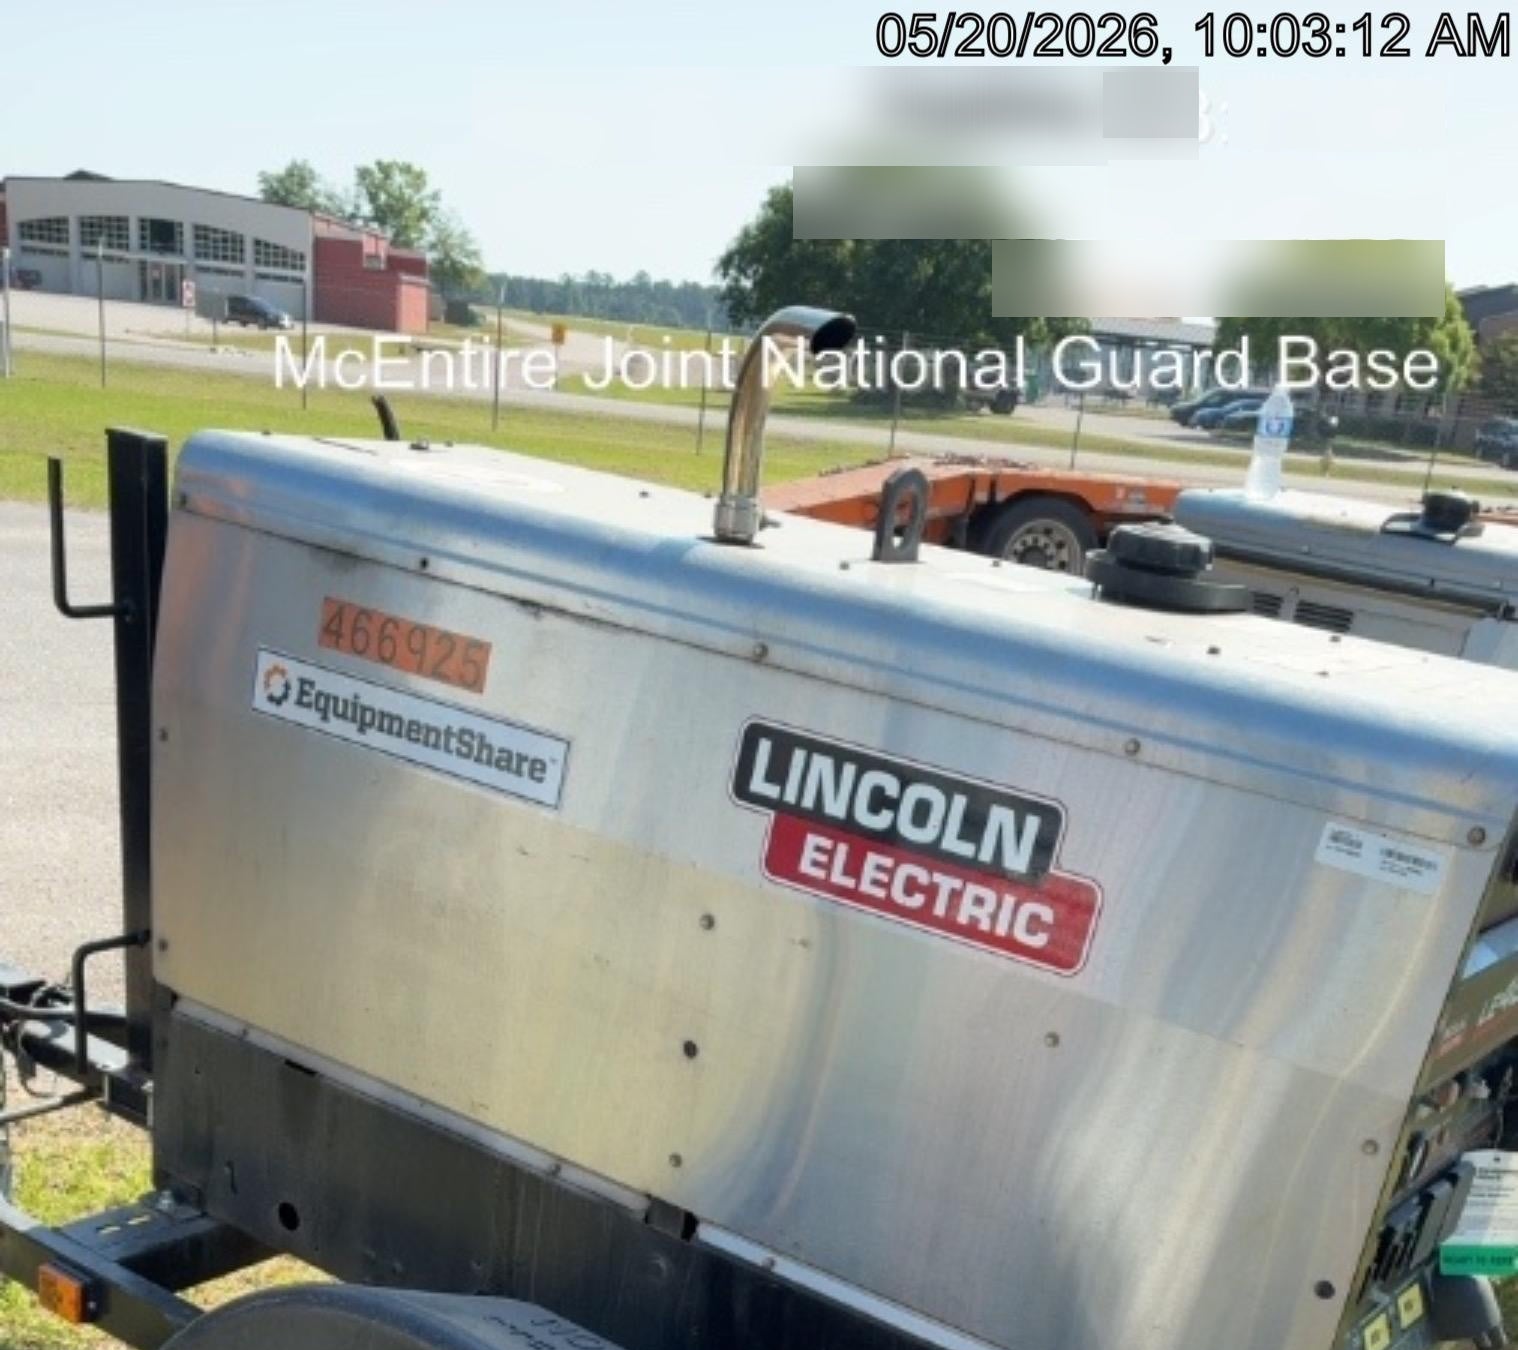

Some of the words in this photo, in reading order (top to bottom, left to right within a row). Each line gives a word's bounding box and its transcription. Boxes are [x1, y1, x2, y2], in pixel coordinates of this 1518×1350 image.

[321, 602, 484, 690] 466925
[294, 676, 548, 784] EquipmentShare
[748, 737, 1042, 874] LINCOLN
[798, 832, 1055, 949] ELECTRIC
